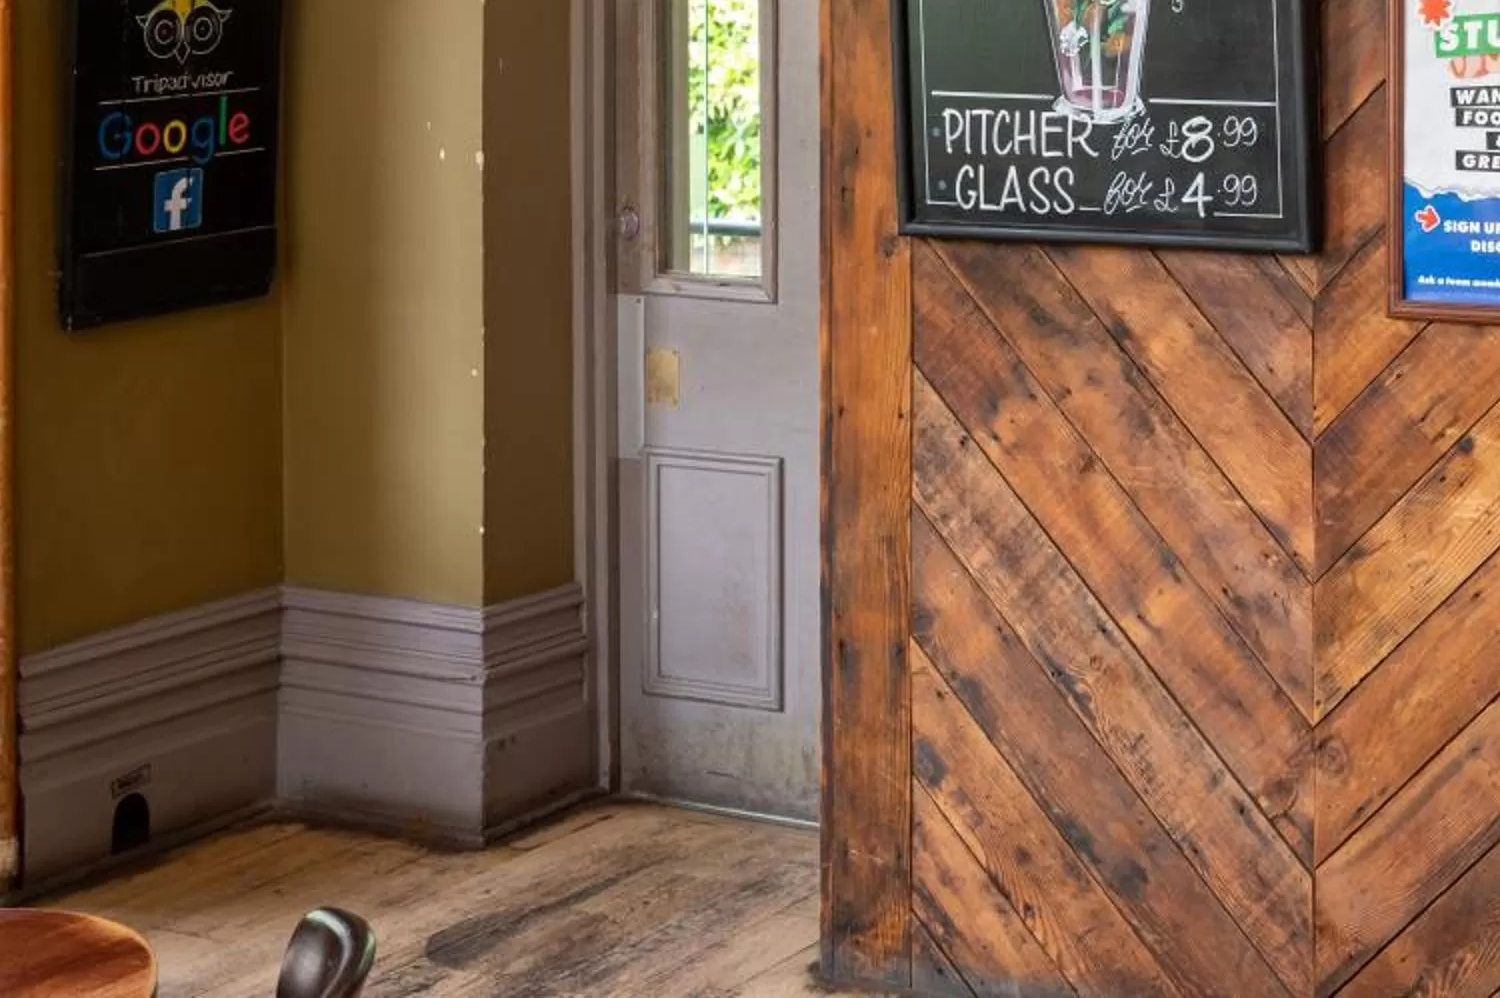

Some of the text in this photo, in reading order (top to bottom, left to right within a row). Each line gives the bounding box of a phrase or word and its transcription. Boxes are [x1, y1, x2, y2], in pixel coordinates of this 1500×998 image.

[132, 71, 234, 94] Tripadvisor
[99, 95, 250, 165] Google
[942, 107, 1099, 158] PITCHER
[955, 163, 1075, 215] GLASS
[1443, 220, 1480, 234] SIGN
